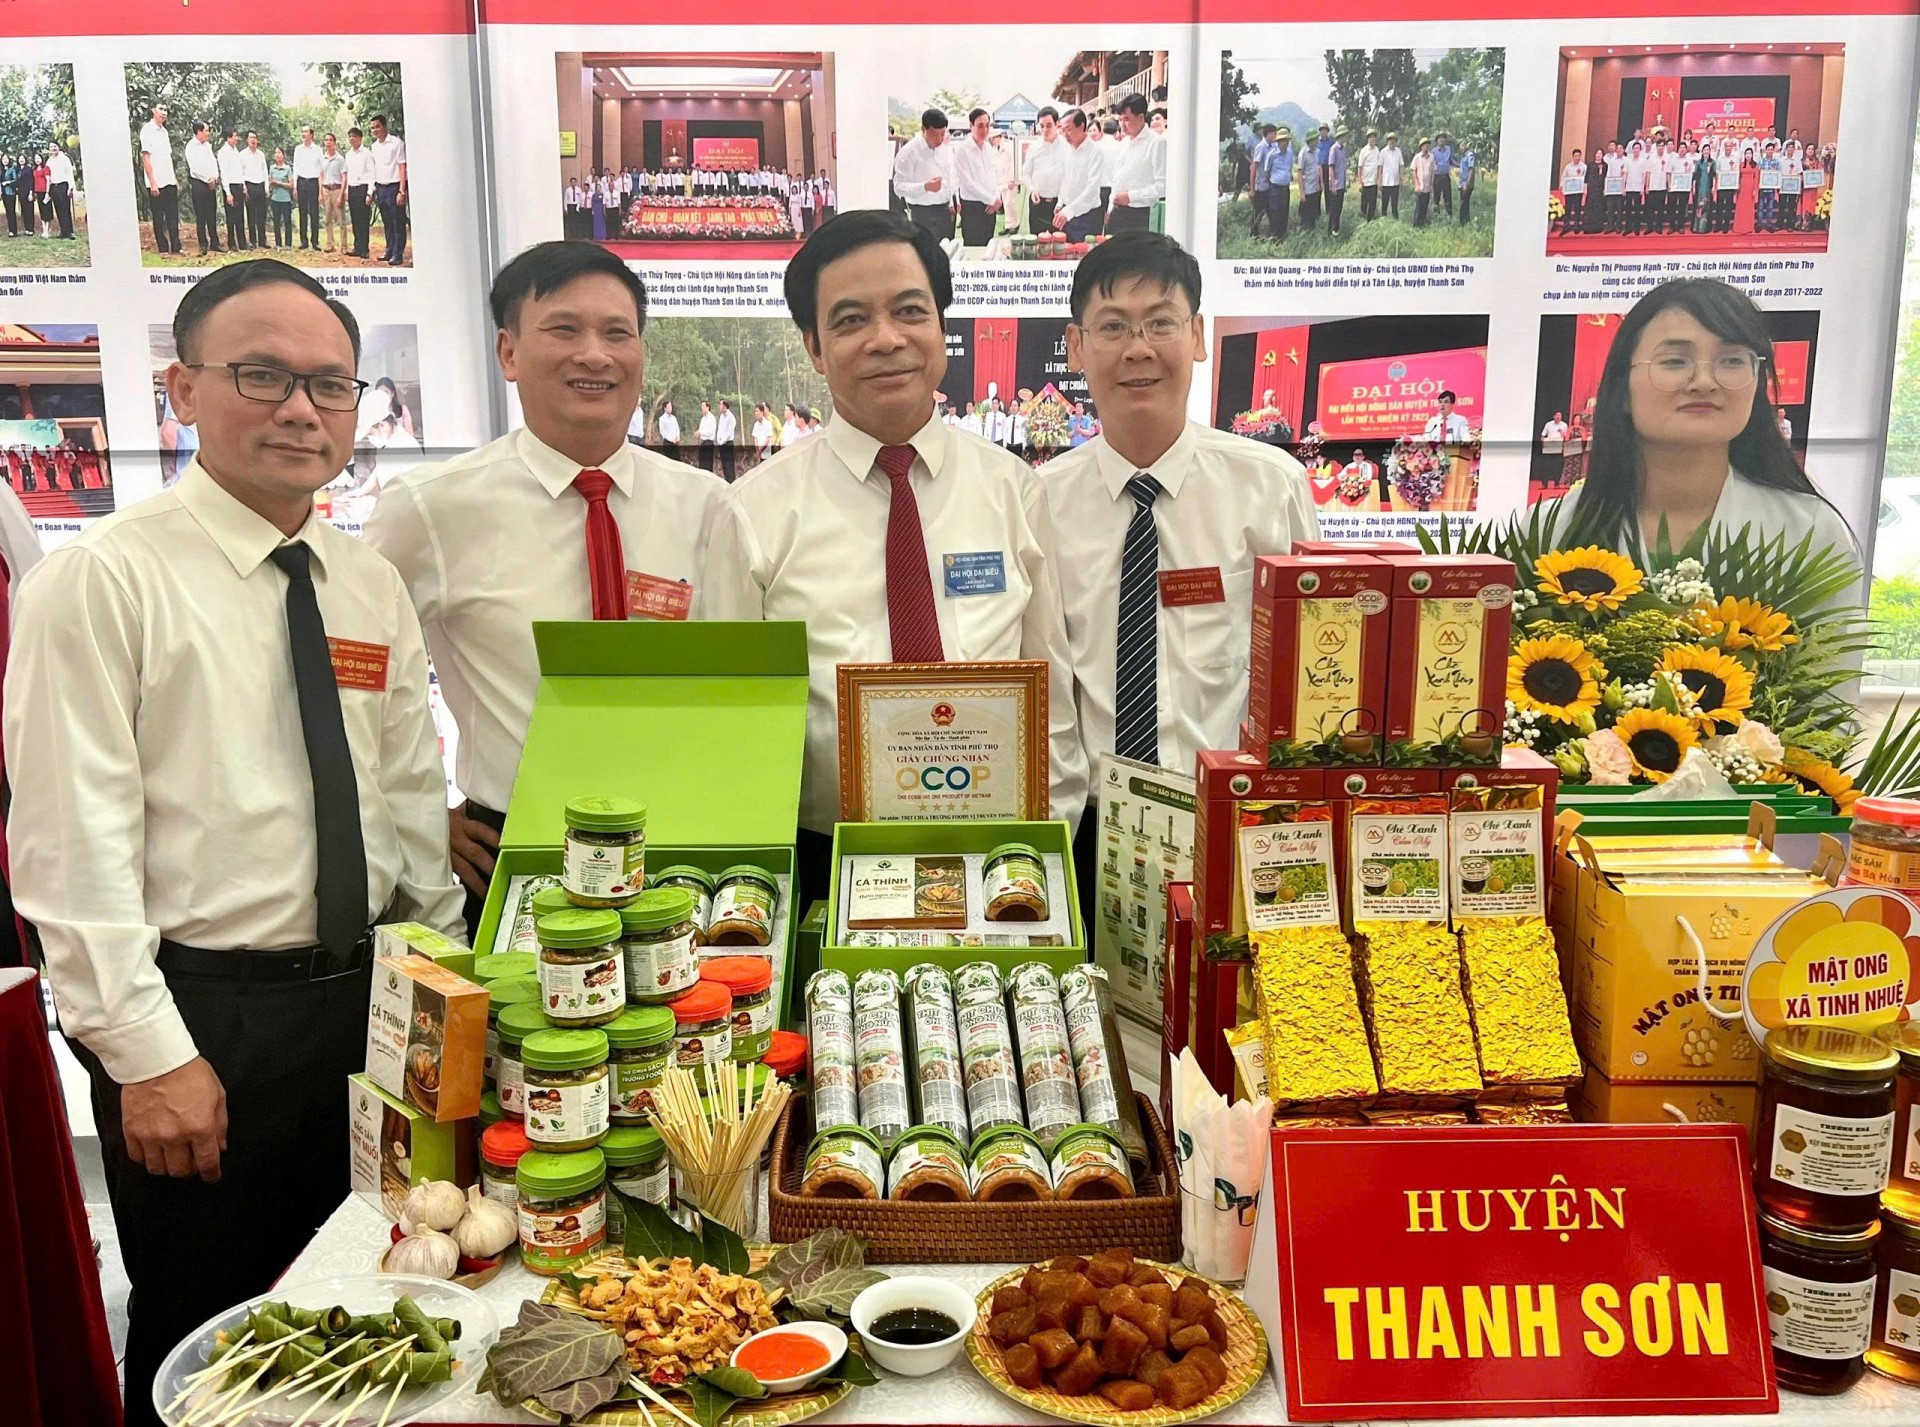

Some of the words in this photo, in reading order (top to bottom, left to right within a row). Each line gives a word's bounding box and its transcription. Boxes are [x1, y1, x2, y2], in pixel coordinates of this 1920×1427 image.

[1408, 265, 1428, 273] UBND
[51, 275, 67, 283] Nam
[1428, 278, 1449, 287] Thanh
[1727, 275, 1749, 283] Thanh
[736, 284, 755, 293] Thanh
[1783, 288, 1823, 296] 2017-2022
[701, 297, 720, 306] Thanh
[967, 297, 984, 305] OCOP
[1020, 297, 1040, 305] Thanh
[1352, 385, 1392, 401] ĐẠI
[1400, 377, 1445, 397] HỘI
[923, 753, 959, 763] CHỨNG
[962, 754, 990, 764] NHẬN
[895, 765, 992, 791] OCOP
[856, 878, 870, 886] CÁ
[873, 877, 908, 885] THÍNH
[1254, 872, 1278, 881] OCOP
[1808, 956, 1848, 987] MẬT
[1854, 953, 1887, 979] ONG
[1786, 994, 1811, 1019] XÃ
[1817, 993, 1859, 1017] TINH
[1865, 980, 1904, 1012] NHUỆ
[371, 1003, 381, 1019] CÁ
[383, 1009, 406, 1033] THÍNH
[1632, 1000, 1670, 1036] MẬT
[362, 1139, 379, 1162] MUỐI
[1403, 1173, 1627, 1243] HUYỆN
[1323, 1283, 1561, 1360] THANH
[1580, 1275, 1729, 1359] SƠN
